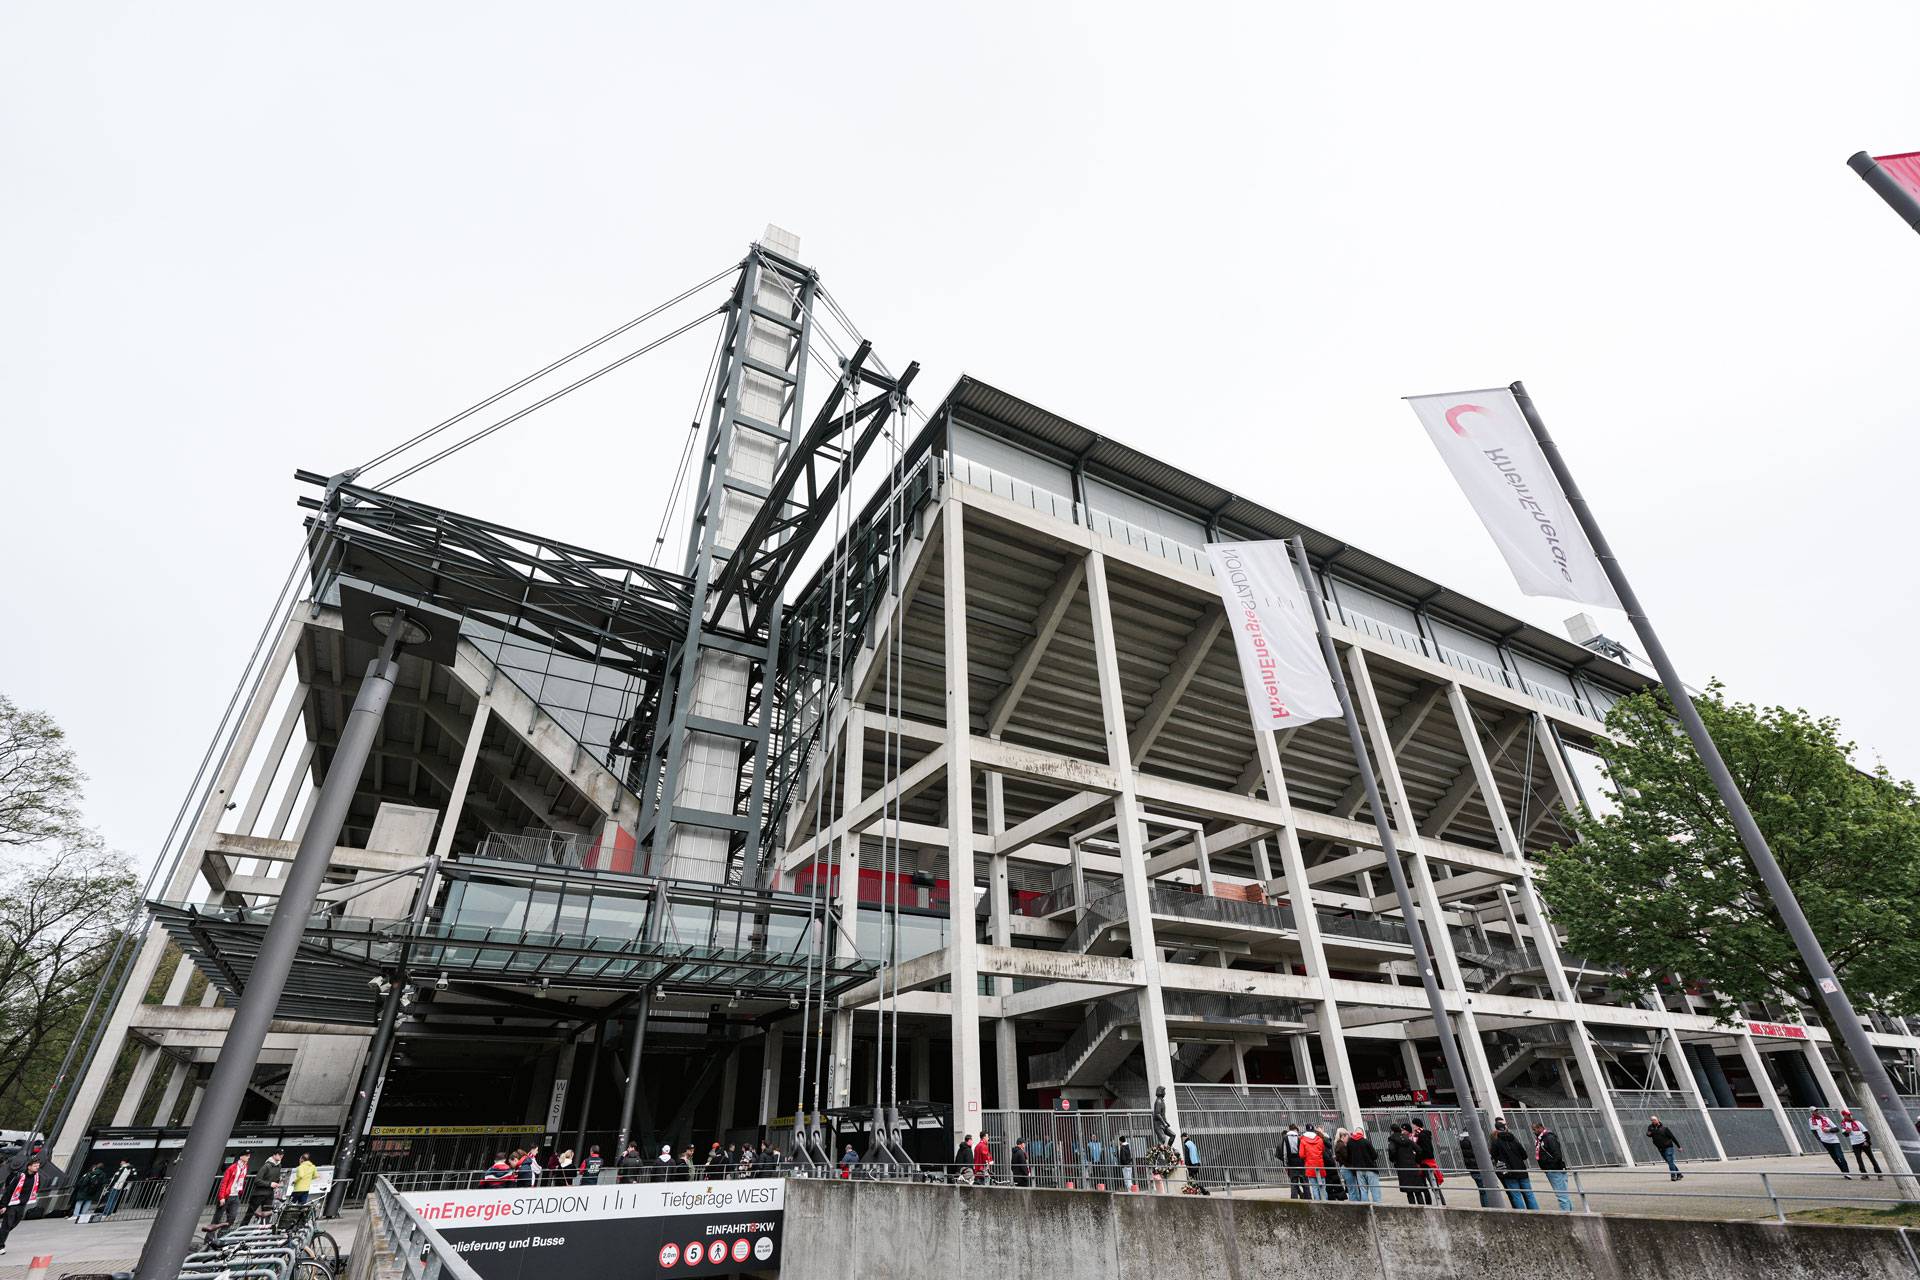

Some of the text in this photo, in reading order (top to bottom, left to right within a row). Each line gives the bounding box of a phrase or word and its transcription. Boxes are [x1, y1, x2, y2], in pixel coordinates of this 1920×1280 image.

[552, 1081, 566, 1125] WEST
[415, 1188, 778, 1221] inEnergieSTADION Tiefgarage WEST
[706, 1223, 751, 1235] EINFAHRT
[451, 1236, 565, 1252] nlieferung und Busse
[690, 1247, 698, 1260] 5
